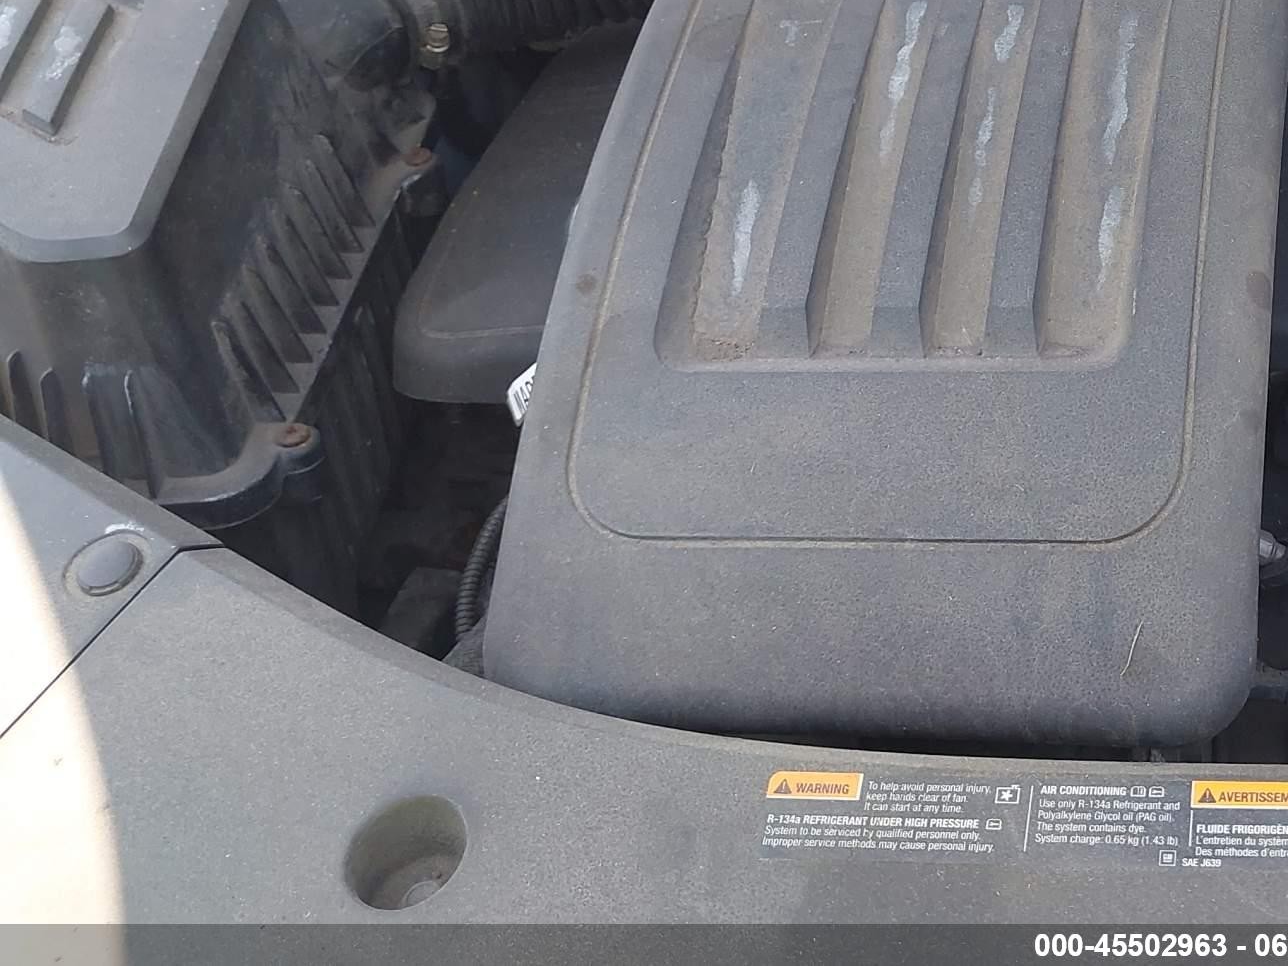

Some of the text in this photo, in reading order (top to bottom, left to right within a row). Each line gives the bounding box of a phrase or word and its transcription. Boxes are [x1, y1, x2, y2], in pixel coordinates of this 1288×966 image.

[796, 782, 849, 794] WARNING
[869, 781, 878, 791] To
[880, 781, 899, 794] help
[901, 782, 925, 792] avoid
[926, 783, 963, 795] personal
[1040, 785, 1127, 796] AIR CONDITIONING
[866, 792, 886, 802] keep
[889, 792, 915, 801] hands
[918, 793, 938, 802] clear
[941, 793, 951, 802] of
[864, 802, 870, 811] It
[872, 803, 888, 811] can
[890, 803, 910, 812] start
[912, 803, 922, 812] at
[923, 804, 939, 814] any
[1039, 799, 1180, 811] Use only R-134a Refrigerant and
[767, 814, 980, 829] R-134a REFRIGERANT UNDER HIGH PRESSURE
[1038, 810, 1091, 821] Polyalkylene
[1094, 811, 1120, 822] Glycol
[1122, 812, 1133, 821] oil
[1135, 812, 1156, 823] (PAG
[765, 825, 797, 836] System
[800, 826, 808, 835] to
[810, 826, 821, 835] be
[823, 827, 860, 837] serviced
[863, 828, 873, 839] by
[876, 829, 914, 840] qualified
[915, 830, 959, 841] personnel
[1037, 821, 1053, 831] The
[1054, 822, 1087, 832] system
[1088, 823, 1126, 833] contains
[1196, 824, 1230, 834] FLUIDE
[762, 837, 802, 848] Improper
[804, 838, 835, 847] service
[838, 838, 876, 848] methods
[879, 840, 897, 850] may
[900, 842, 925, 850] cause
[928, 842, 966, 852] personal
[1035, 833, 1068, 844] System
[1105, 835, 1126, 844] 0.65
[1127, 835, 1139, 846] kg
[1141, 835, 1164, 846] (1.43
[1166, 836, 1179, 846] lb)
[1244, 836, 1256, 845] du
[1195, 846, 1212, 856] Des
[1215, 847, 1259, 857] méthodes
[1182, 858, 1222, 867] SAE J639
